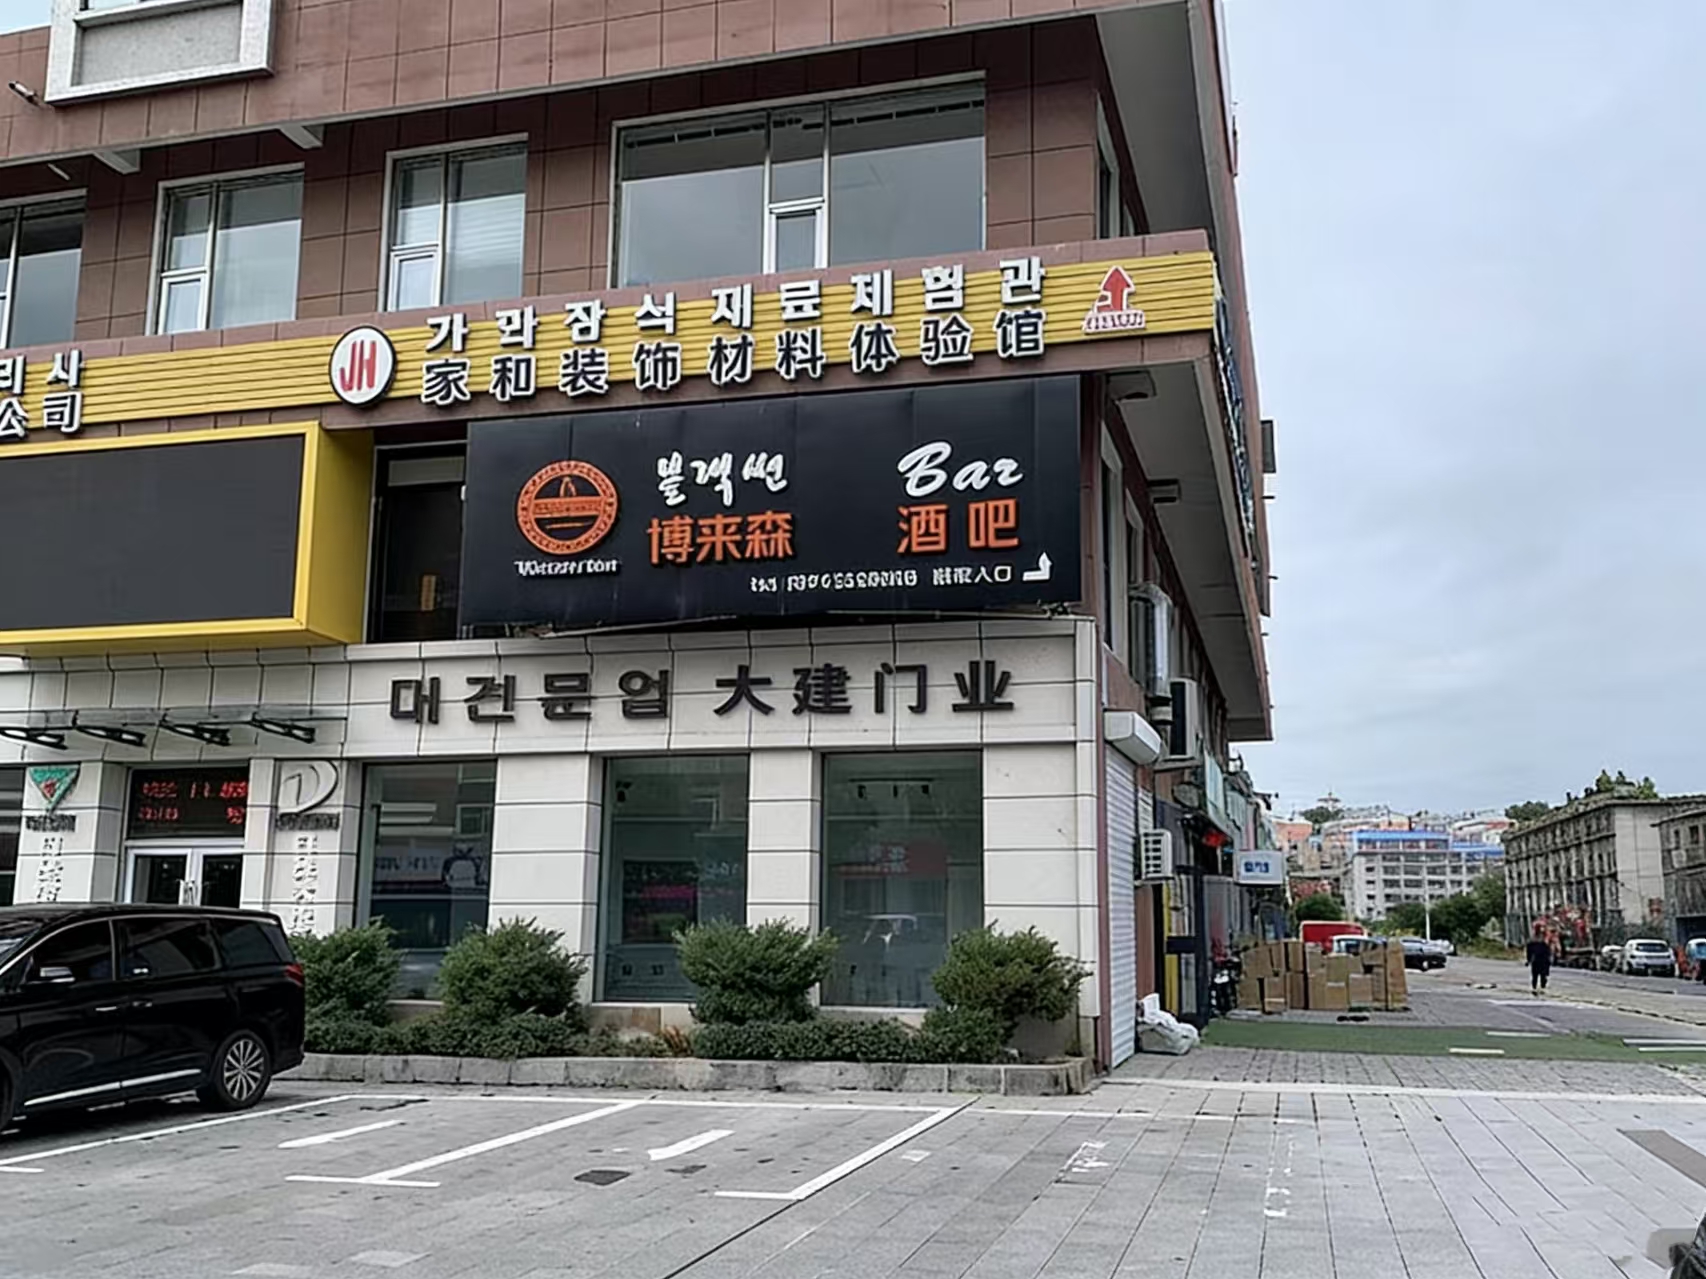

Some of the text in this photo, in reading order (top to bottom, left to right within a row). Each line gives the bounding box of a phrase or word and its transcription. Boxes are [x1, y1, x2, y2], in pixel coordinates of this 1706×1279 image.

[422, 309, 1046, 405] 家和装饰材料体验馆
[0, 392, 83, 438] 公司
[897, 441, 1024, 498] Bar
[647, 511, 793, 565] 博来森
[896, 498, 1020, 555] 酒吧
[389, 660, 1014, 725] 대건문업 大建门业
